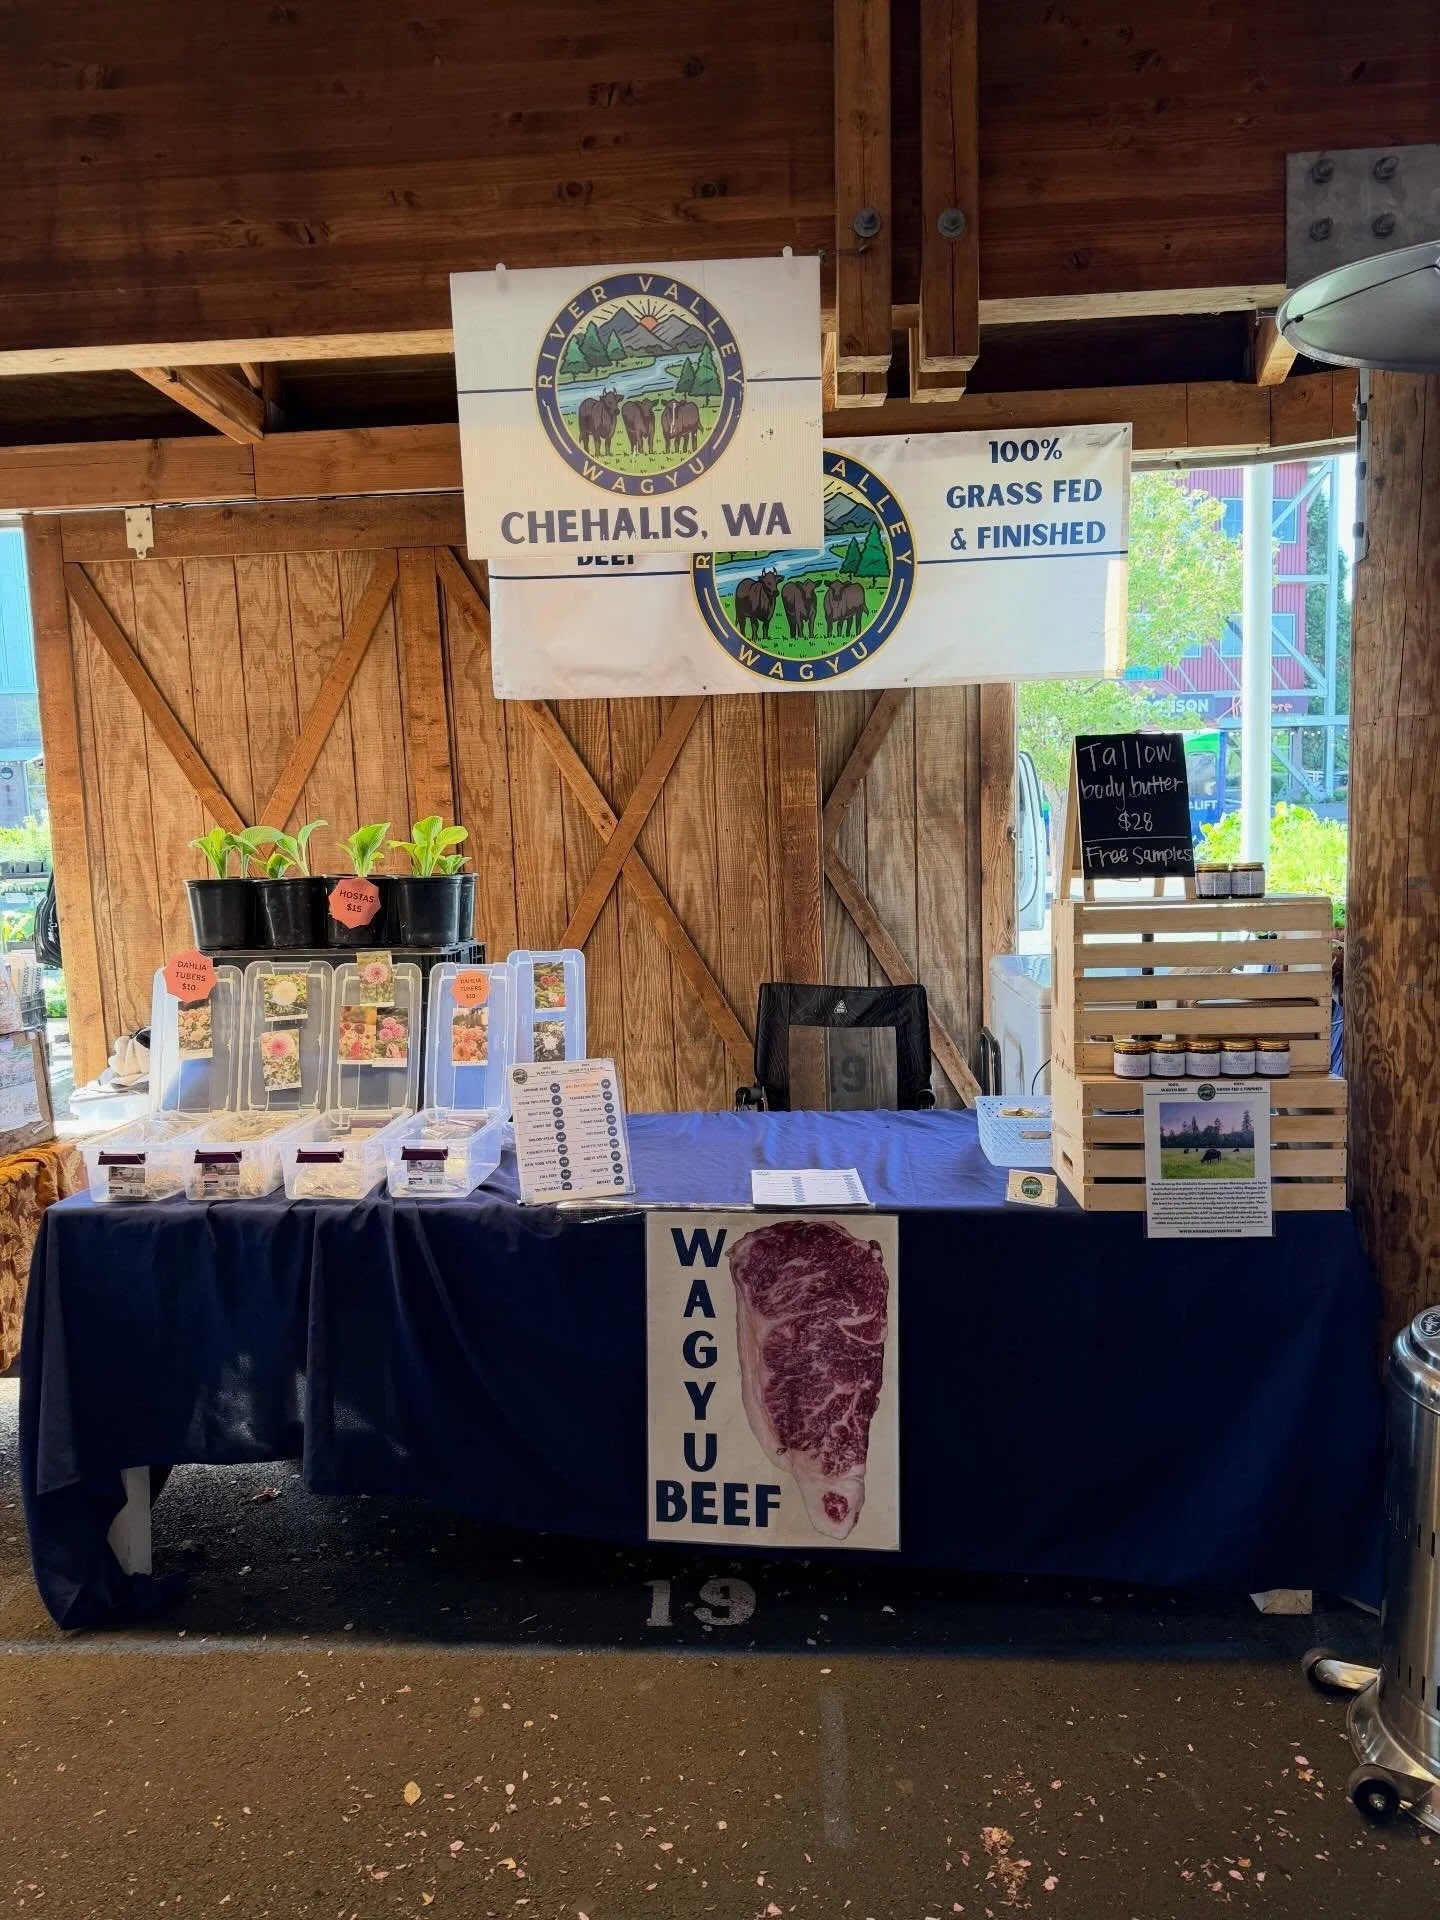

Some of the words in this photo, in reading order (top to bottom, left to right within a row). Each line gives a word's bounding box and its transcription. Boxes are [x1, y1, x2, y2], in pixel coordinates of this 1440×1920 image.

[537, 285, 608, 390] RIVER
[638, 276, 743, 384] VALLEY
[988, 437, 1063, 463] 100%
[581, 460, 705, 494] WAGYU
[946, 481, 1043, 509] GRASS
[1053, 478, 1103, 503] FED
[501, 505, 708, 544] CHEHALIS,
[721, 501, 792, 537] WA
[830, 459, 912, 565] ALLEY
[950, 527, 967, 550] &
[977, 521, 1106, 549] FINISHED
[737, 642, 868, 680] WAGYU
[1080, 775, 1126, 811] body
[1129, 775, 1184, 798] butter
[1118, 810, 1153, 832] $28
[1086, 846, 1129, 868] Free
[340, 890, 375, 903] HOSTAS
[347, 903, 362, 913] $15
[176, 972, 206, 982] TUBERS
[177, 961, 207, 971] DAHLIA
[182, 983, 196, 991] $10
[671, 1228, 727, 1472] WAGYU
[656, 1479, 782, 1528] BEEF
[643, 1577, 757, 1627] 19
